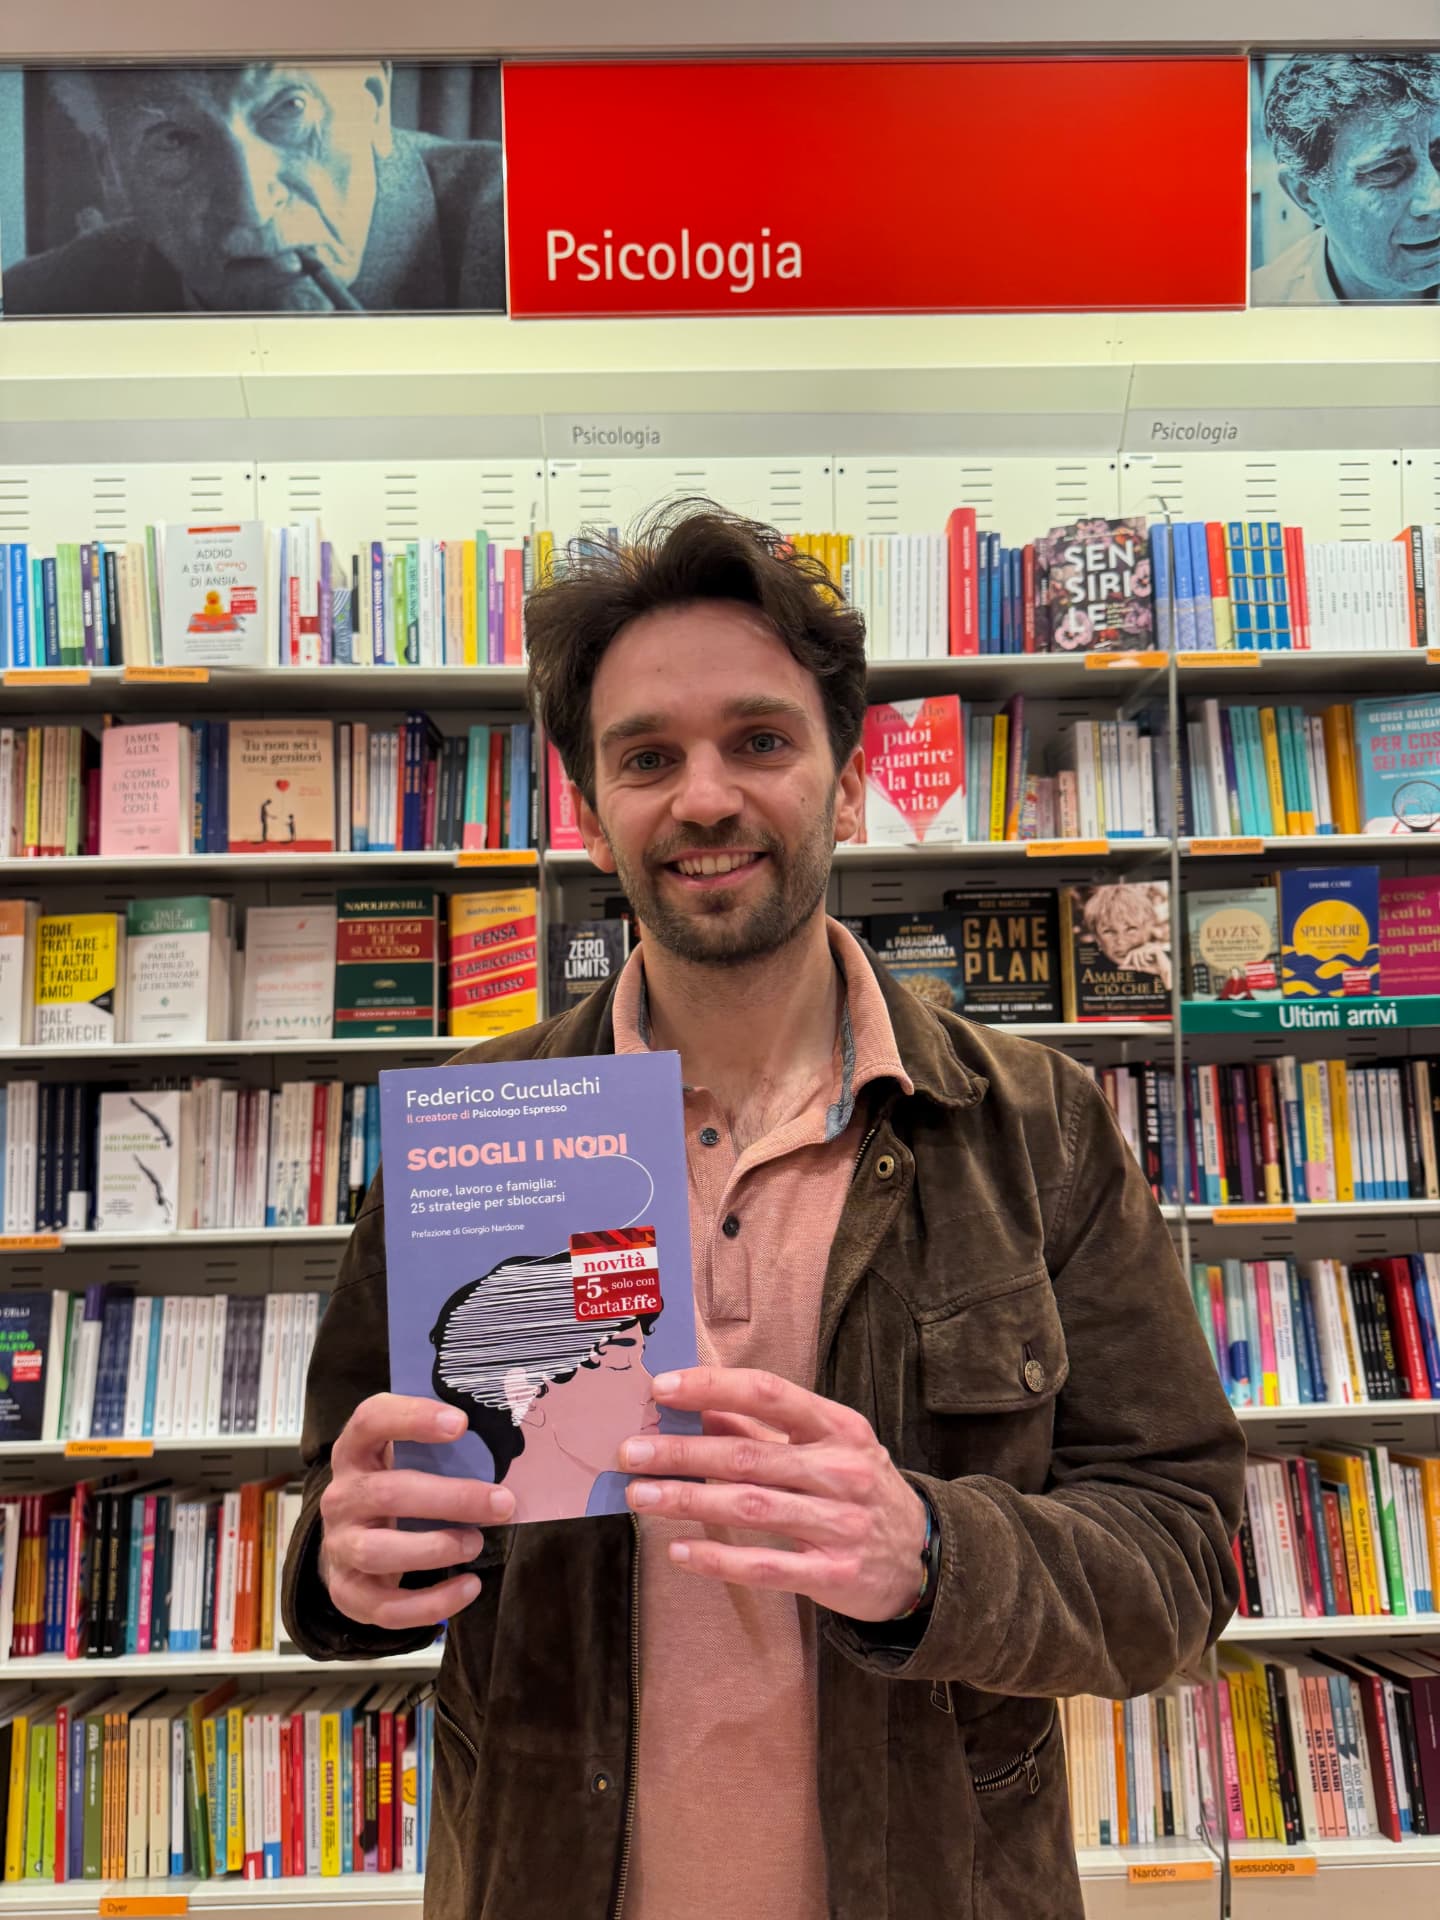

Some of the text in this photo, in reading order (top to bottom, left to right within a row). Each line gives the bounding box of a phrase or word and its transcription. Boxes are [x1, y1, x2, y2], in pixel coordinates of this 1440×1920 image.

[546, 227, 802, 293] Psicologia
[572, 425, 661, 449] Psicologia
[1151, 421, 1239, 445] Psicologia
[196, 548, 233, 560] ADDIO
[1063, 539, 1135, 573] SEN
[1068, 603, 1108, 633] LE
[124, 732, 161, 746] JAMES
[243, 737, 260, 751] Tu
[264, 741, 289, 751] non
[293, 737, 310, 751] sei
[882, 721, 932, 753] puoi
[1370, 735, 1403, 753] PER
[125, 744, 161, 756] ALLEN
[241, 749, 322, 765] tuoi genitori
[871, 744, 954, 779] guarire
[1373, 754, 1396, 772] SEI
[123, 767, 158, 780] COME
[887, 769, 951, 791] la tua
[132, 778, 171, 791] UOMO
[123, 791, 159, 804] PENSA
[898, 789, 939, 812] vita
[1392, 890, 1425, 903] cose
[41, 922, 72, 938] COME
[348, 924, 364, 935] LE
[381, 921, 423, 934] LEGGI
[472, 925, 518, 946] PENSA
[962, 916, 1048, 949] GAME
[1206, 924, 1262, 940] LO ZEN
[1387, 925, 1415, 937] mia
[41, 937, 98, 953] TRATTARE
[371, 936, 399, 945] DEL
[568, 938, 605, 960] ZERO
[41, 952, 95, 968] GLI ALTRI
[350, 945, 421, 958] SUCCESSO
[51, 968, 98, 983] FARSELI
[564, 957, 610, 979] LIMITS
[964, 951, 1049, 984] PLAN
[1082, 968, 1136, 984] AMARE
[40, 985, 73, 1000] AMICI
[484, 977, 526, 997] STESSO
[1122, 982, 1148, 995] CHE
[1153, 976, 1165, 993] È
[39, 1008, 72, 1025] DALE
[1279, 1001, 1398, 1028] Ultimi arrivi
[40, 1023, 107, 1043] CARNEGIE
[407, 1076, 600, 1108] Federico Cuculachi
[407, 1103, 567, 1124] Il creatore di Psicologo Espresso
[407, 1133, 628, 1172] SCIOGLI I NODI
[410, 1178, 557, 1200] Amore, lavoro e famiglia:
[411, 1192, 566, 1214] 25 strategie per sbloccarsi
[411, 1223, 526, 1239] Prefazione di Giorgio Nardone
[583, 1251, 646, 1274] novità
[612, 1278, 633, 1290] solo
[635, 1277, 655, 1287] con
[578, 1293, 658, 1317] CartaEffe
[1318, 1752, 1330, 1793] AMANDI
[1329, 1752, 1341, 1792] AMANDI
[1133, 1868, 1176, 1878] Nardone
[1234, 1861, 1296, 1875] sessuologia
[107, 1903, 128, 1914] Dyer
